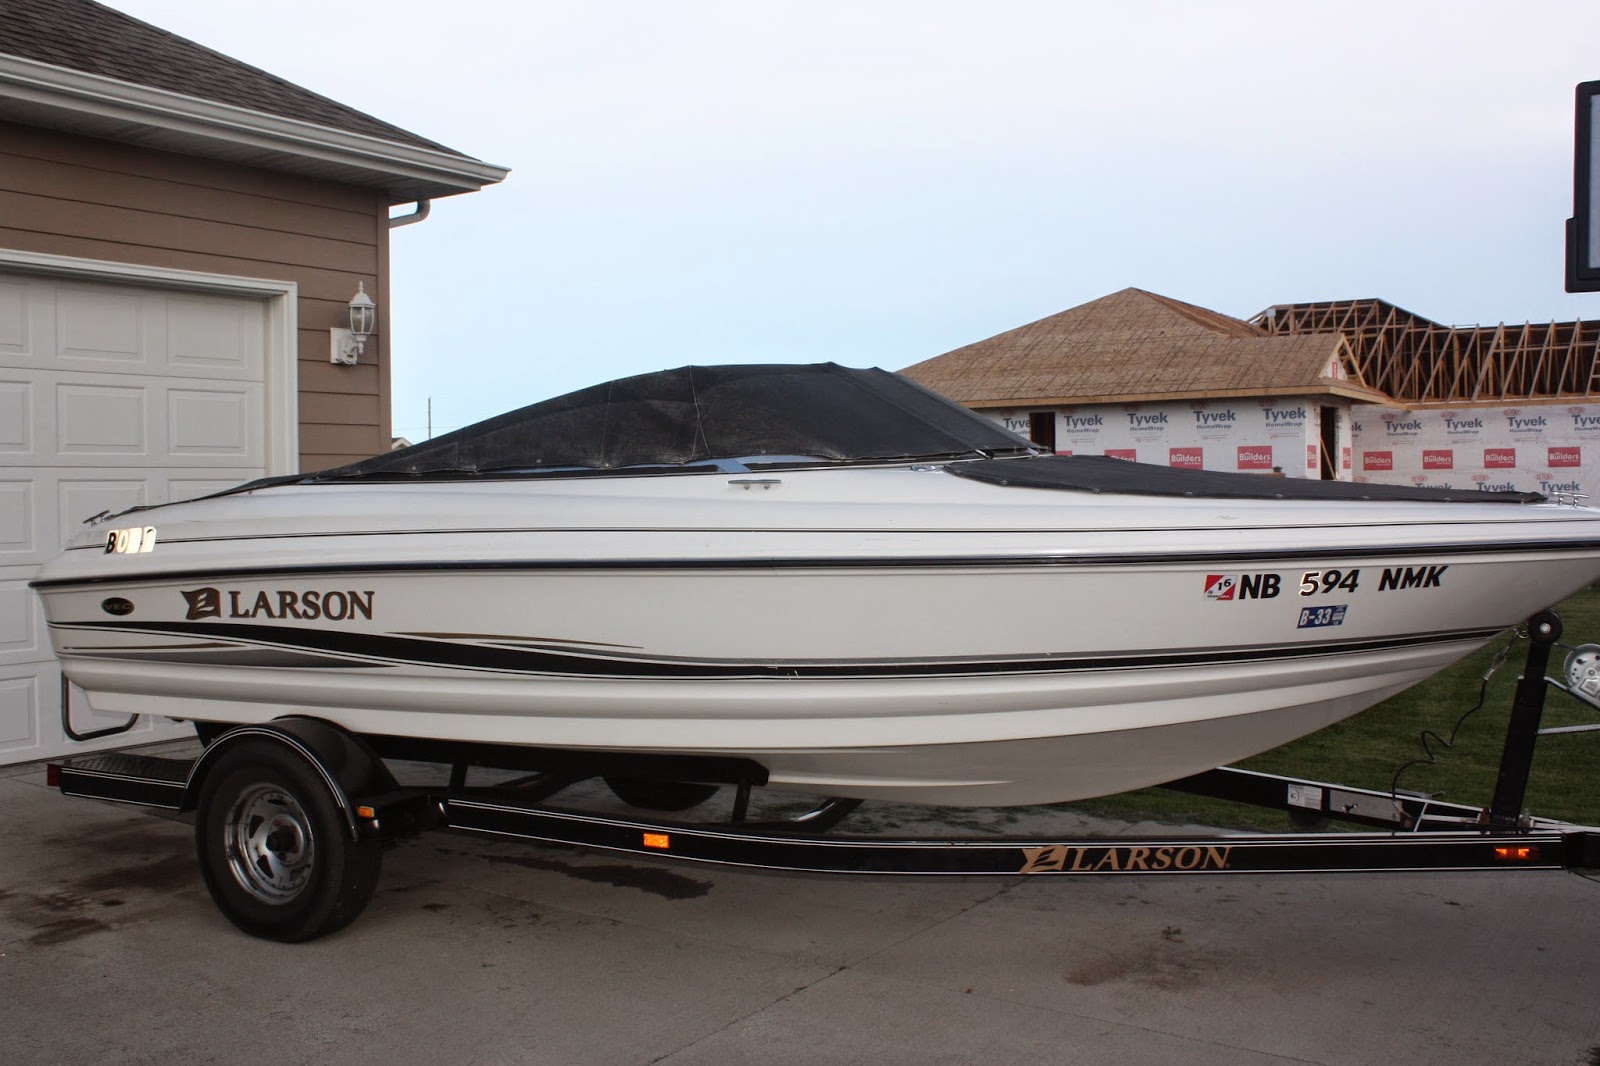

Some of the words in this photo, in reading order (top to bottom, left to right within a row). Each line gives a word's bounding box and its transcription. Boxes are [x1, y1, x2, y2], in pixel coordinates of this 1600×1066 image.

[1127, 412, 1168, 427] Tyvek
[1193, 410, 1236, 424] Tyvek
[1263, 407, 1306, 422] Tyvek
[1571, 414, 1600, 427] Tyve
[1003, 417, 1031, 431] Tyve
[1064, 414, 1103, 429] Tyvek
[1385, 420, 1421, 432] Tyvek
[1445, 418, 1483, 431] Tyvek
[1507, 416, 1547, 429] Tyvek
[1171, 454, 1201, 463] Builders
[1239, 452, 1271, 461] Builders
[1364, 456, 1392, 464] Builders
[1424, 455, 1452, 463] Builders
[1485, 454, 1514, 462] Builders
[1549, 452, 1580, 460] Builders
[1476, 482, 1515, 492] Tyvek
[1539, 481, 1580, 492] Tyvek
[1217, 578, 1232, 591] 16
[1239, 574, 1281, 599] NB
[1299, 569, 1360, 598] 594
[1378, 566, 1449, 592] NMK
[228, 590, 375, 621] LARSON
[1299, 608, 1332, 626] B-33
[1069, 846, 1232, 871] LARSON
